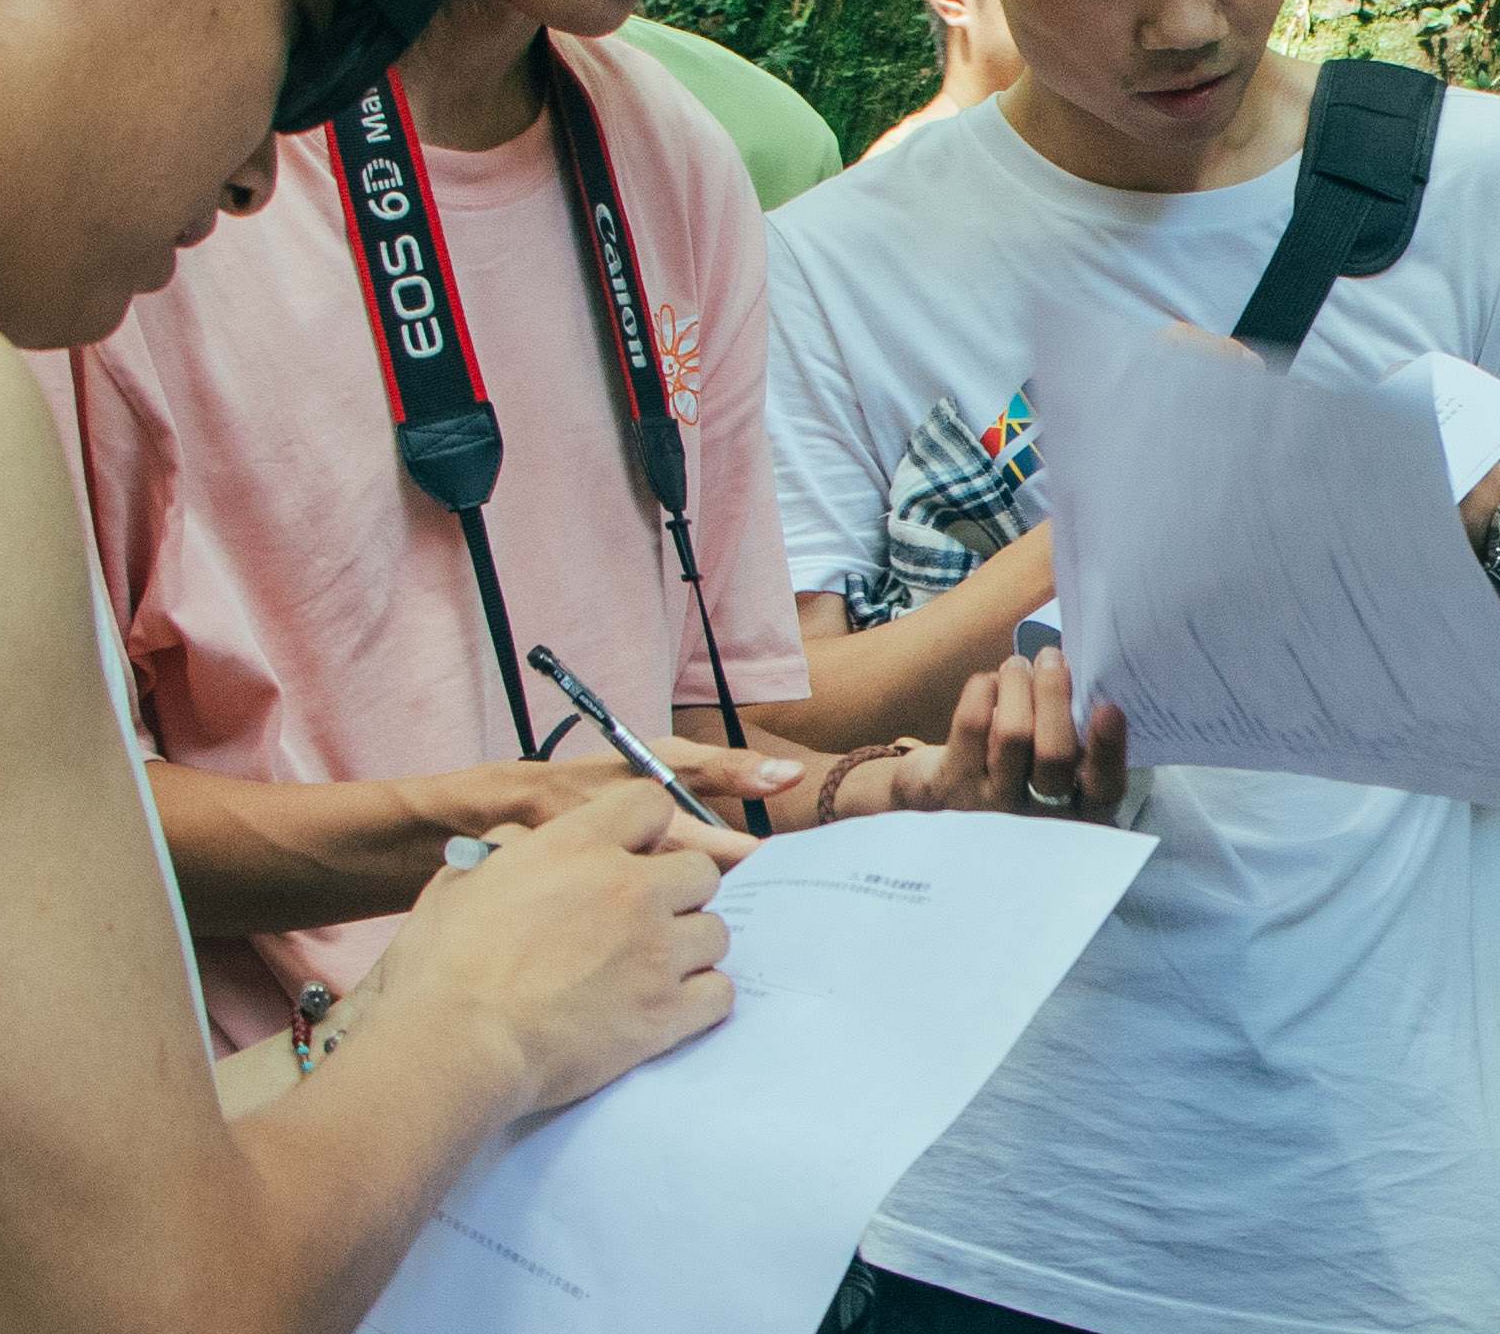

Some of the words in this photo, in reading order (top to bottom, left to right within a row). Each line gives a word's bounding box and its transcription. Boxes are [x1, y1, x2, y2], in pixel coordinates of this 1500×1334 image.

[362, 157, 411, 222] 6D
[380, 234, 445, 359] EOS
[595, 203, 648, 369] Canon
